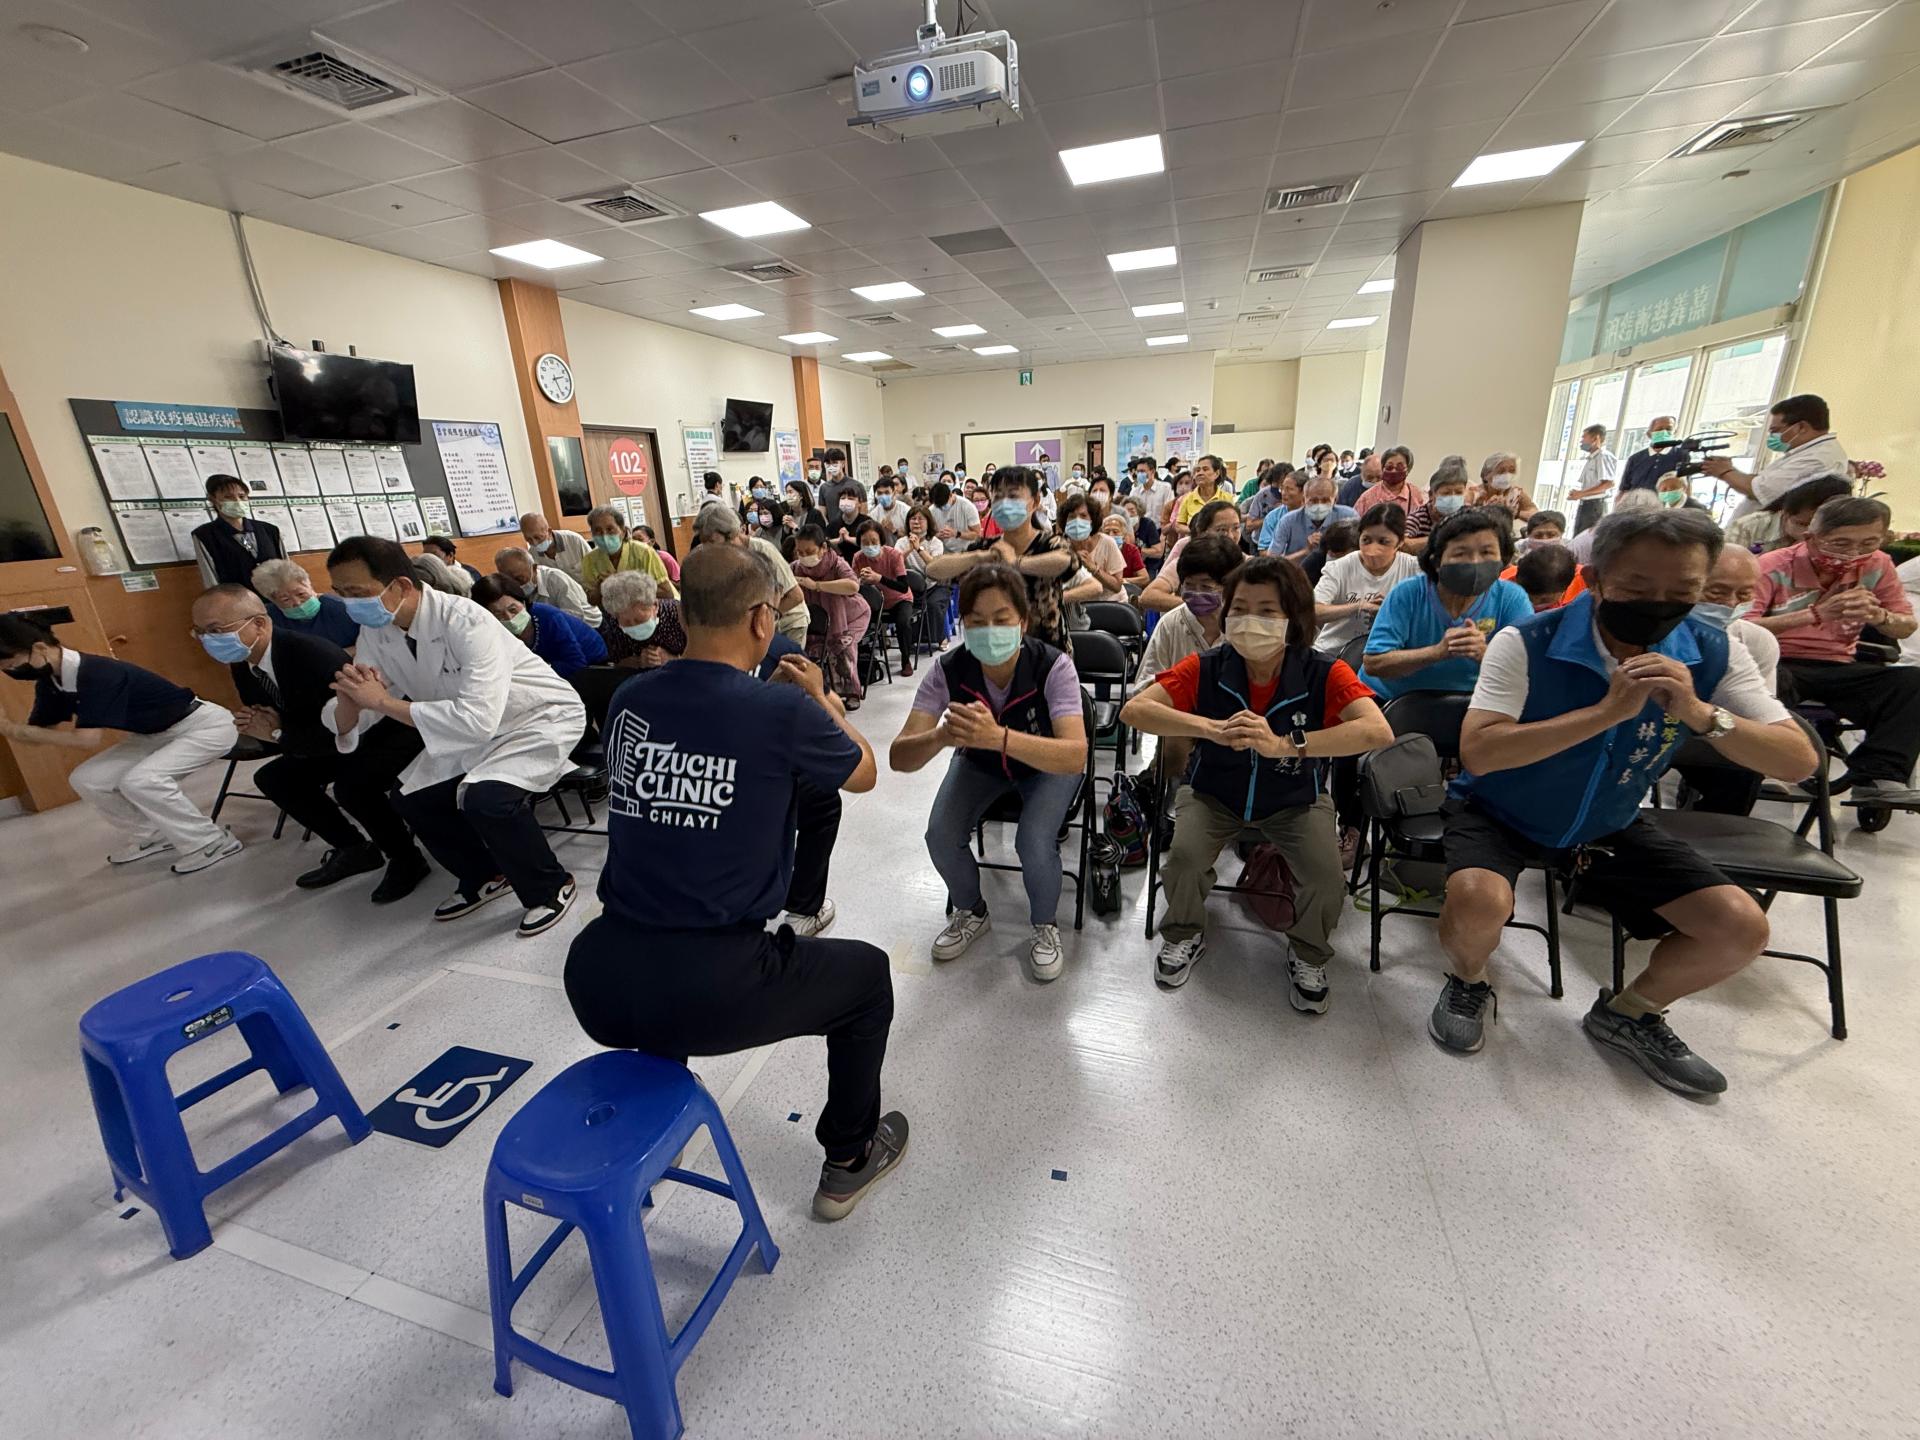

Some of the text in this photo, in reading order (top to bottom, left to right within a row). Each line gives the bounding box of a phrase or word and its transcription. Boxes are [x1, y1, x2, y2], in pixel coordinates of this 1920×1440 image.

[123, 408, 237, 428] 認識免疫風濕疾病
[610, 451, 643, 474] 102
[634, 741, 737, 782] TZUCHI
[635, 771, 735, 807] CLINIC
[649, 808, 719, 830] CHIAYI
